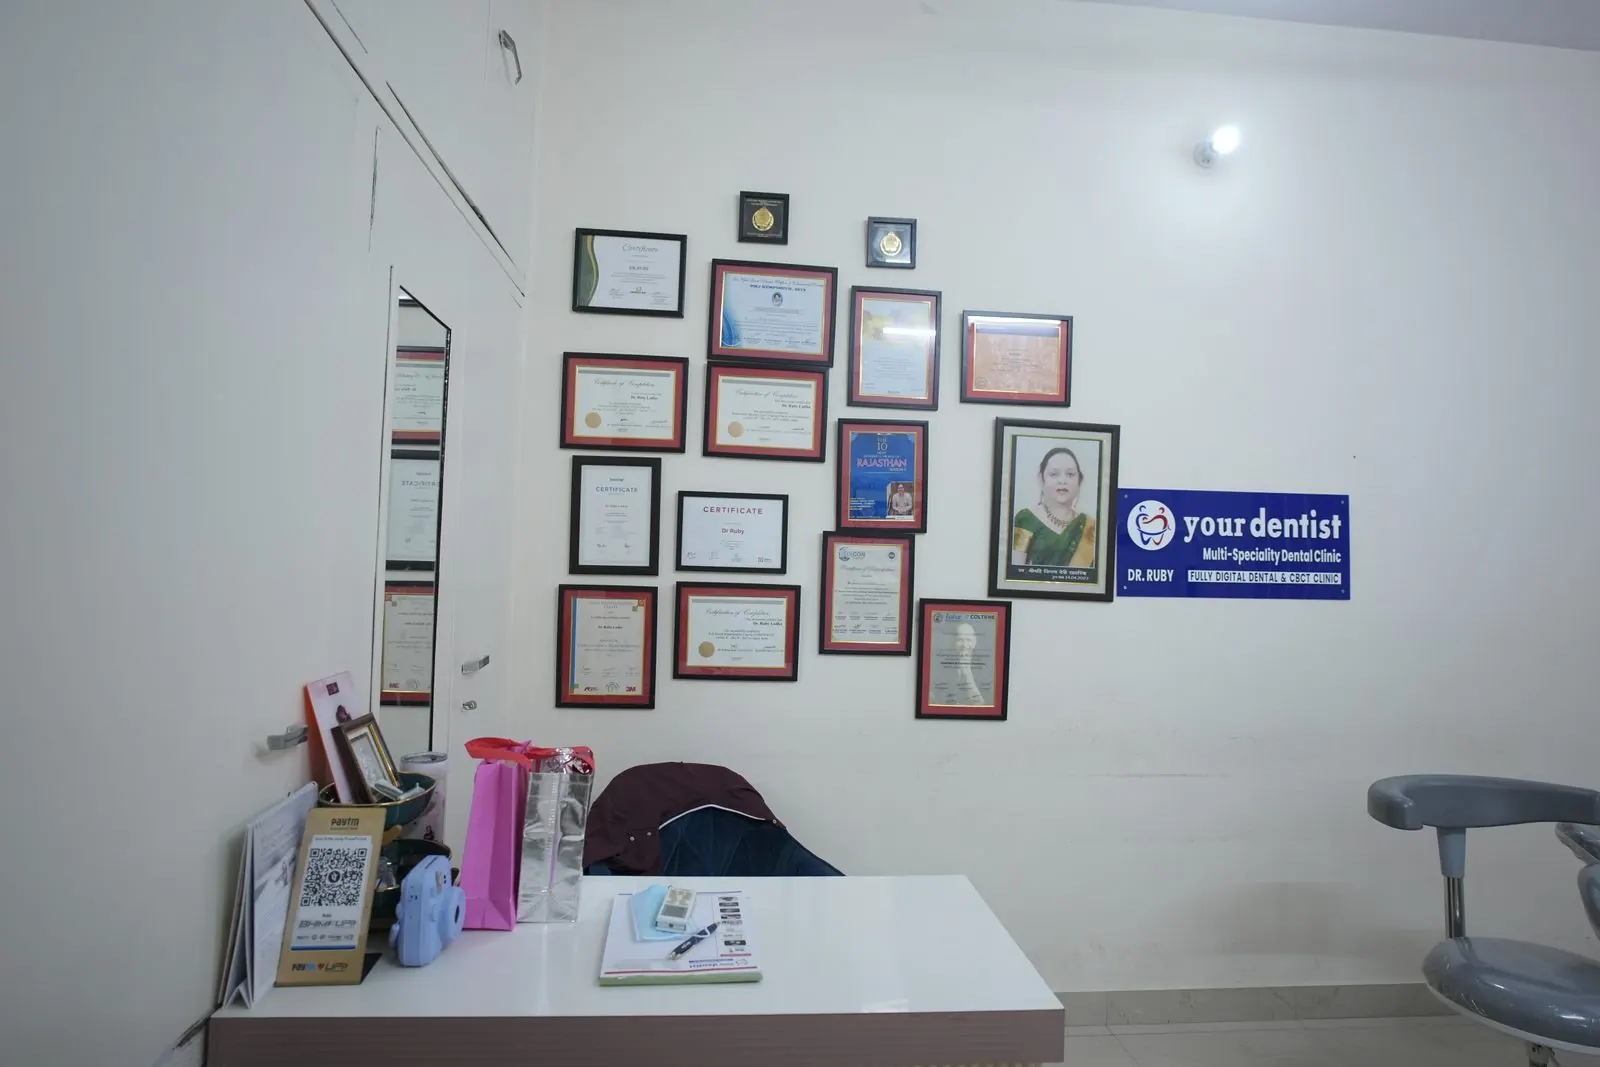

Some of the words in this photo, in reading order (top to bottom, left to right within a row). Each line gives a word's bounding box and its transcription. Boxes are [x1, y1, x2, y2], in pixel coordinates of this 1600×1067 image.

[857, 458, 907, 468] RAJASTHAN
[703, 506, 763, 515] CERTIFICATE
[1183, 516, 1246, 543] your
[1250, 507, 1342, 539] dentist
[1203, 547, 1281, 565] Multi-Speciality
[1281, 549, 1313, 563] Dental
[1313, 550, 1342, 563] Clinic
[1128, 569, 1145, 581] DR.
[1147, 569, 1174, 582] RUBY
[1190, 571, 1213, 581] FULLY
[1216, 572, 1246, 582] DIGITAL
[1249, 572, 1278, 582] DENTAL
[1281, 573, 1287, 582] &
[1289, 573, 1311, 583] CBCT
[1313, 574, 1339, 583] CLINIC
